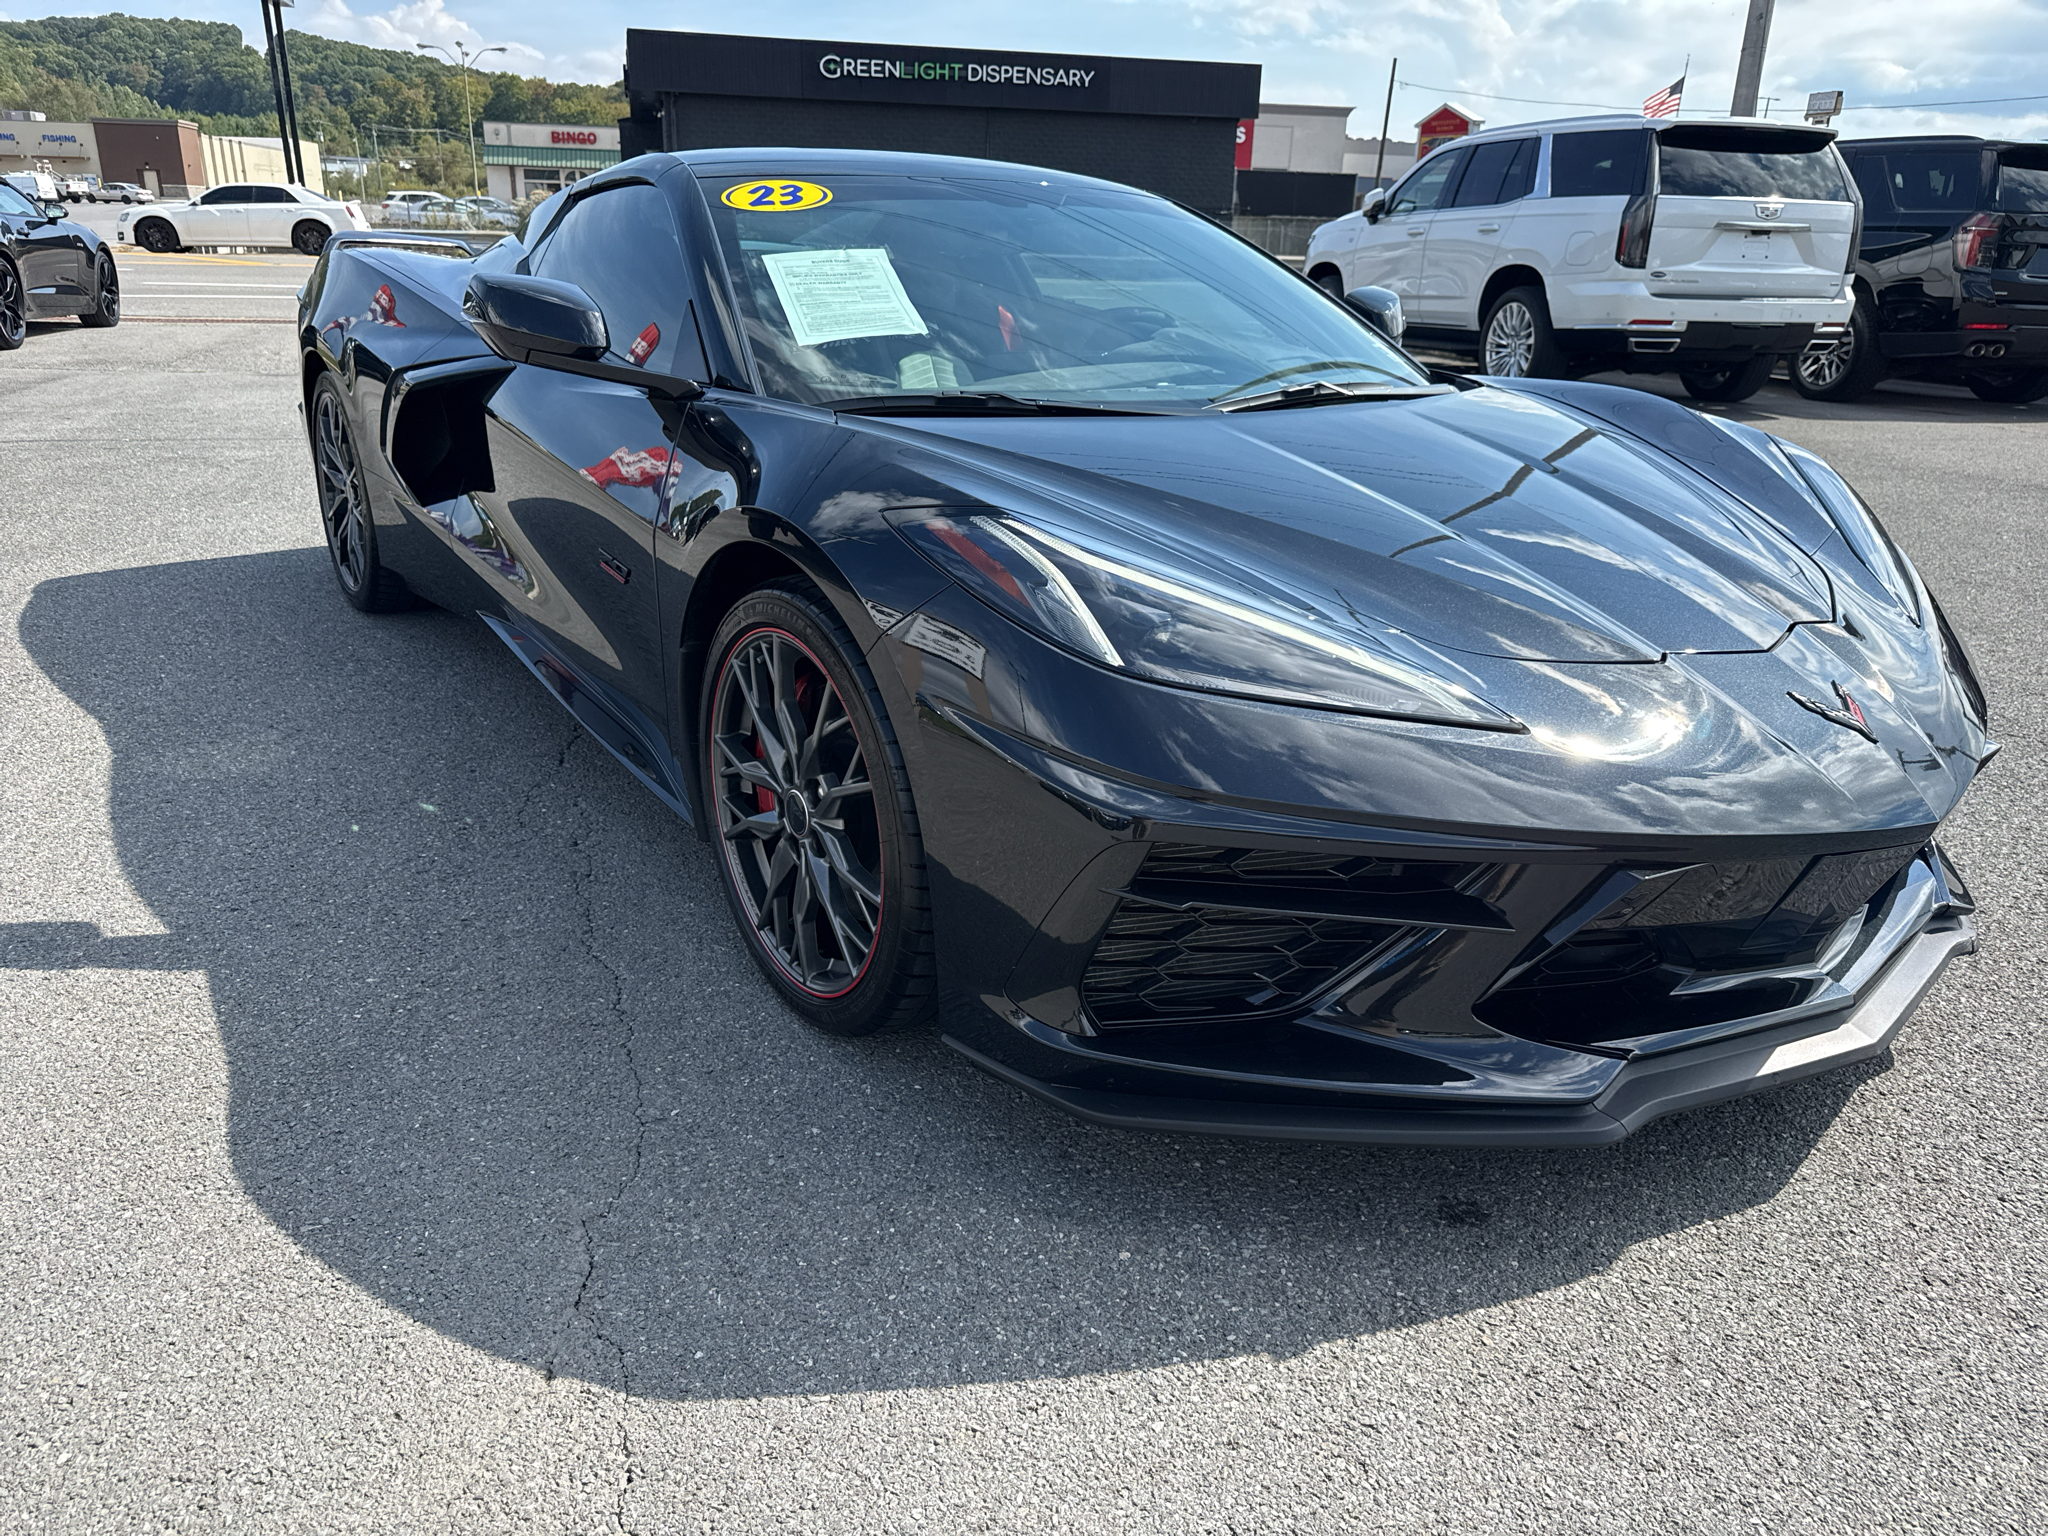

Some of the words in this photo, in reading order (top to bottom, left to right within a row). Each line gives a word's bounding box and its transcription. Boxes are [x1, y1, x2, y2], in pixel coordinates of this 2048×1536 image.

[819, 54, 963, 80] GREENLIGHT
[967, 64, 1095, 88] DISPENSARY
[42, 134, 77, 143] FISHING
[550, 131, 597, 145] BINGO
[747, 184, 804, 207] 23
[755, 602, 806, 629] MICHELIN
